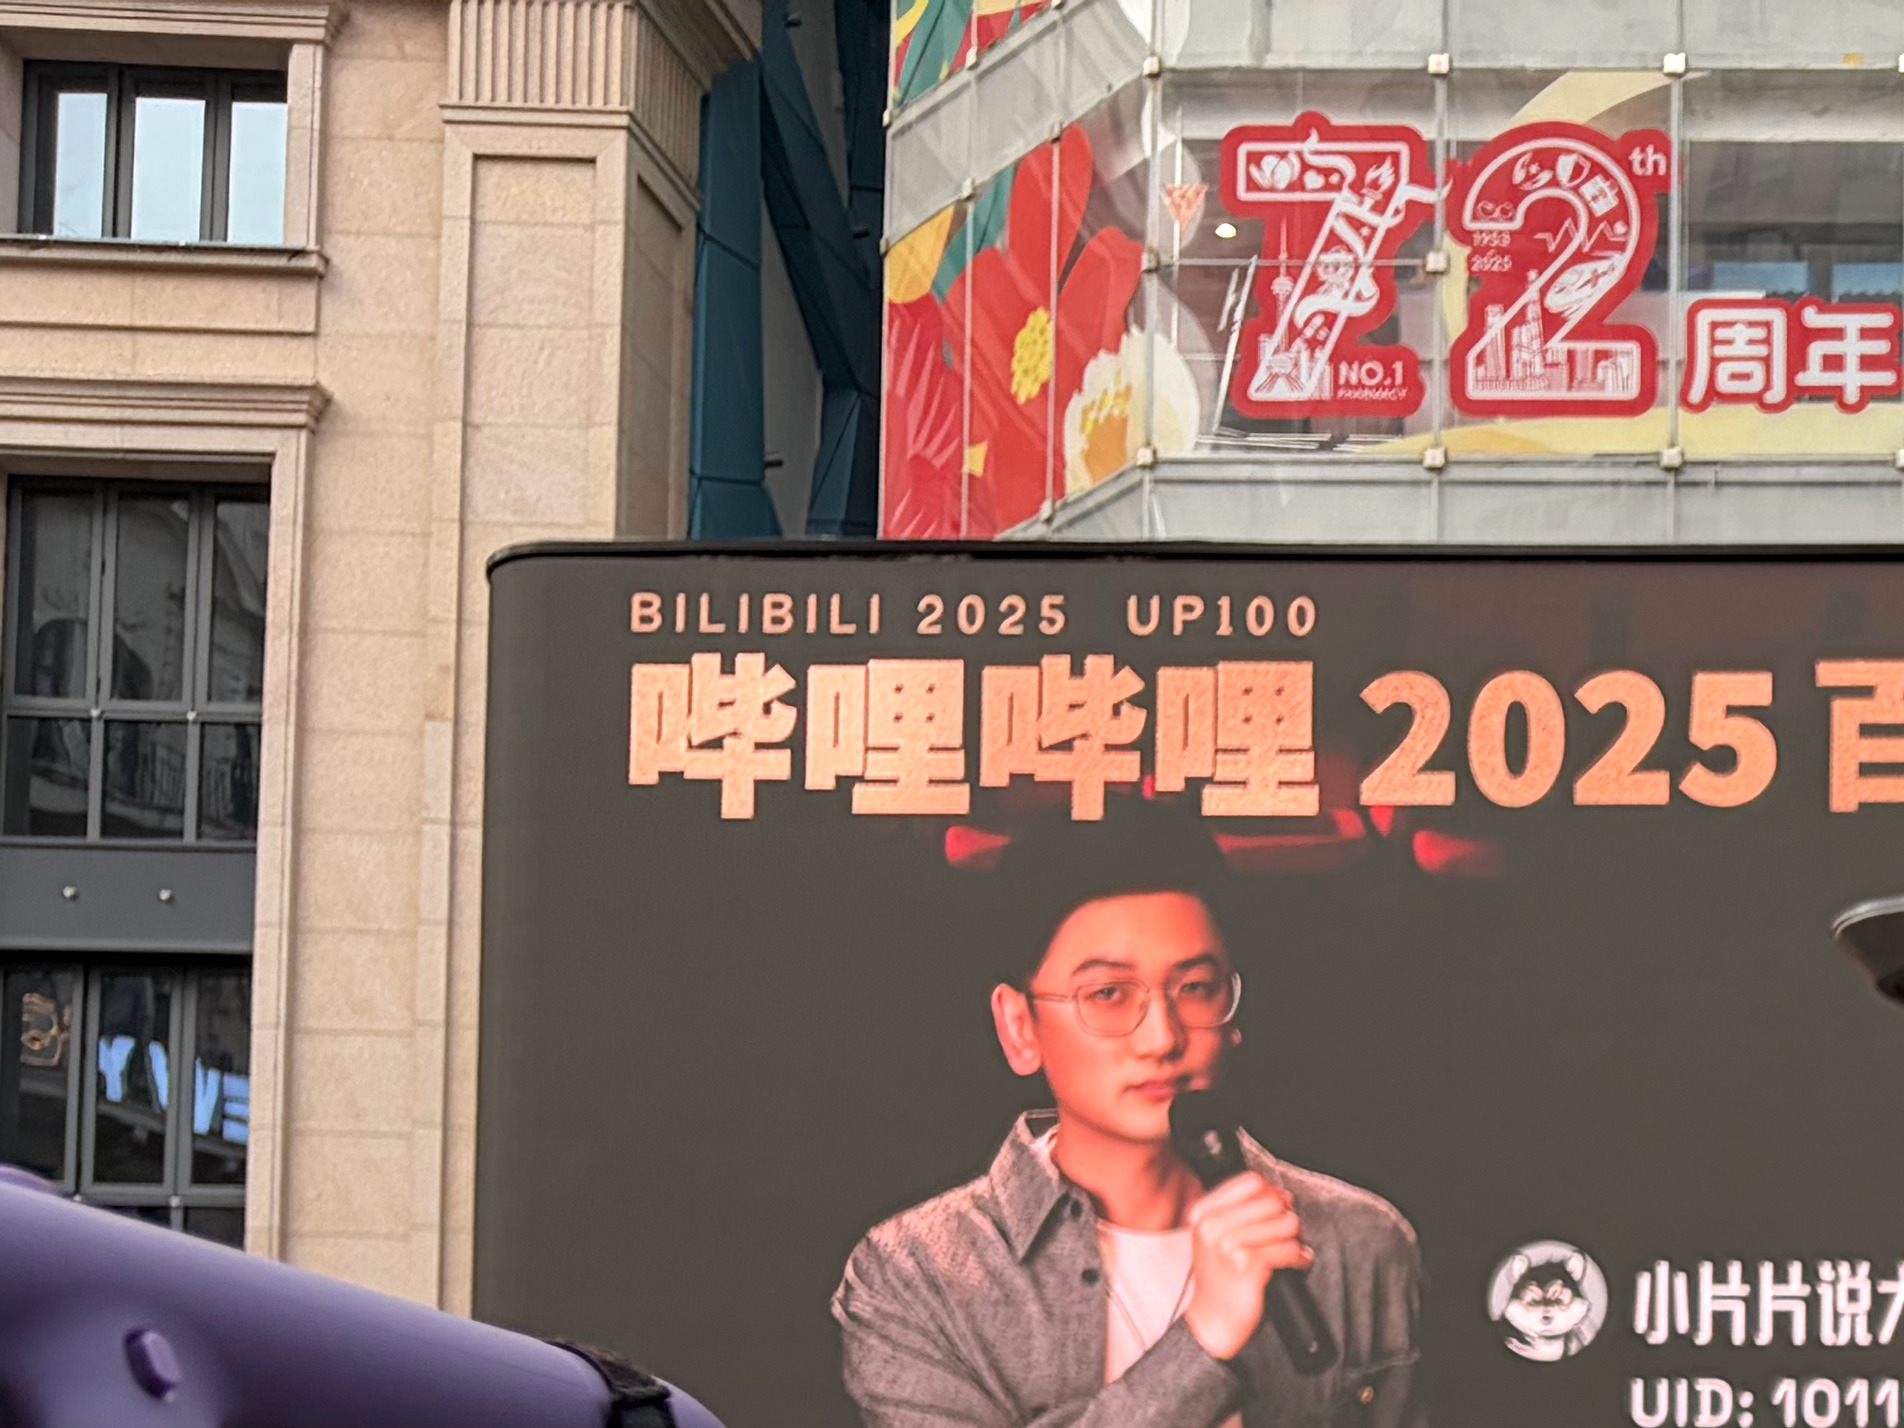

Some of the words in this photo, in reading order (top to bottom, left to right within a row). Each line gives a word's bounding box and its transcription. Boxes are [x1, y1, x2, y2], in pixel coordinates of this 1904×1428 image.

[1338, 360, 1404, 387] NO.1
[1687, 306, 1898, 406] 周年
[629, 592, 882, 635] BILIBILI
[916, 592, 1069, 635] 2025
[1126, 592, 1318, 636] UP100
[628, 651, 1320, 820] 哔哩哔哩
[1358, 668, 1779, 808] 2025
